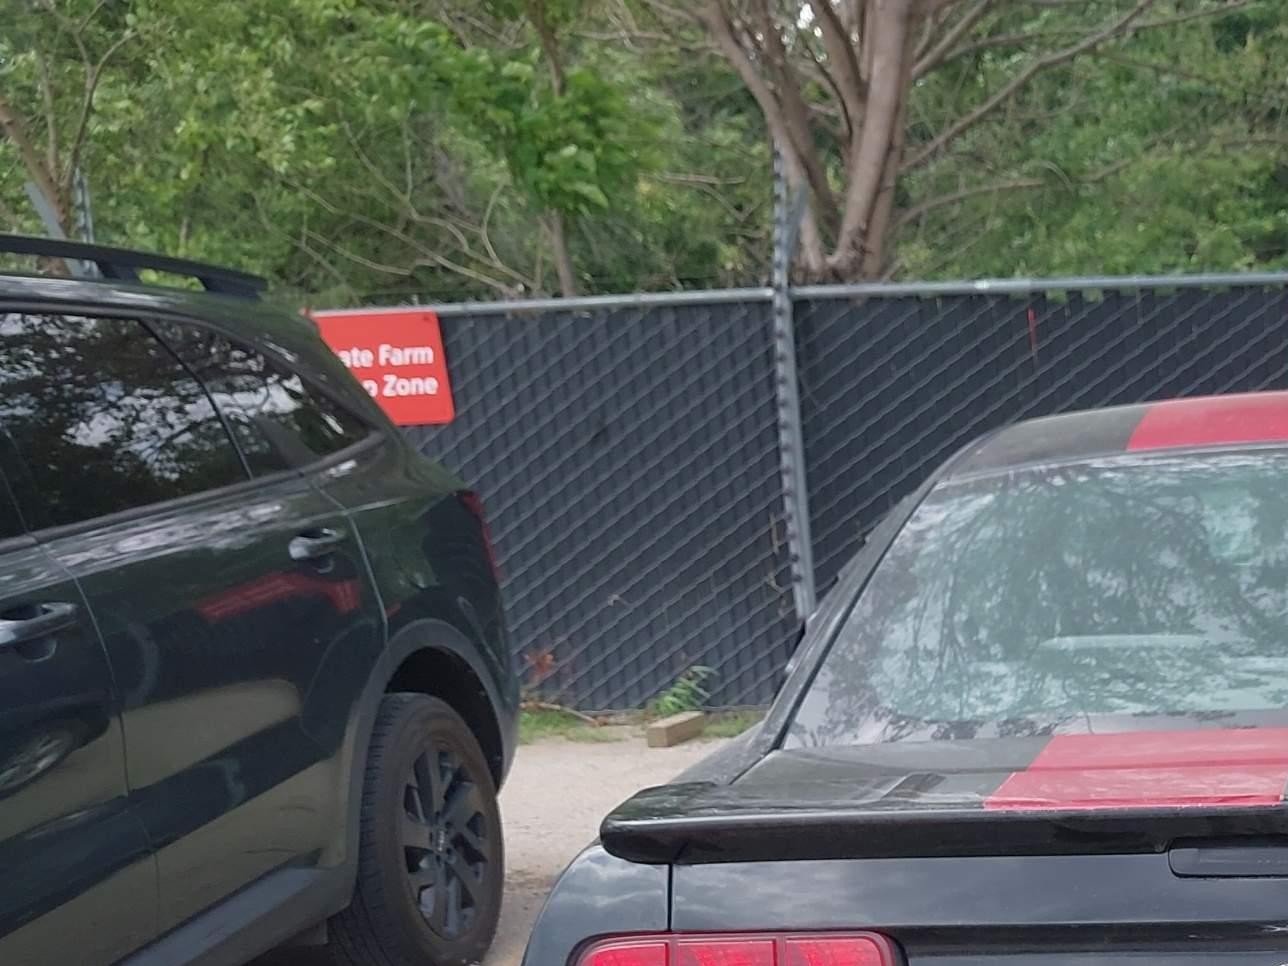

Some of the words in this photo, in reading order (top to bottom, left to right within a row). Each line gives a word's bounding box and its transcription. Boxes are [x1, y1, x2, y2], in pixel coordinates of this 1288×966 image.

[338, 347, 374, 368] ate
[379, 343, 434, 366] Farm
[383, 374, 439, 397] Zone
